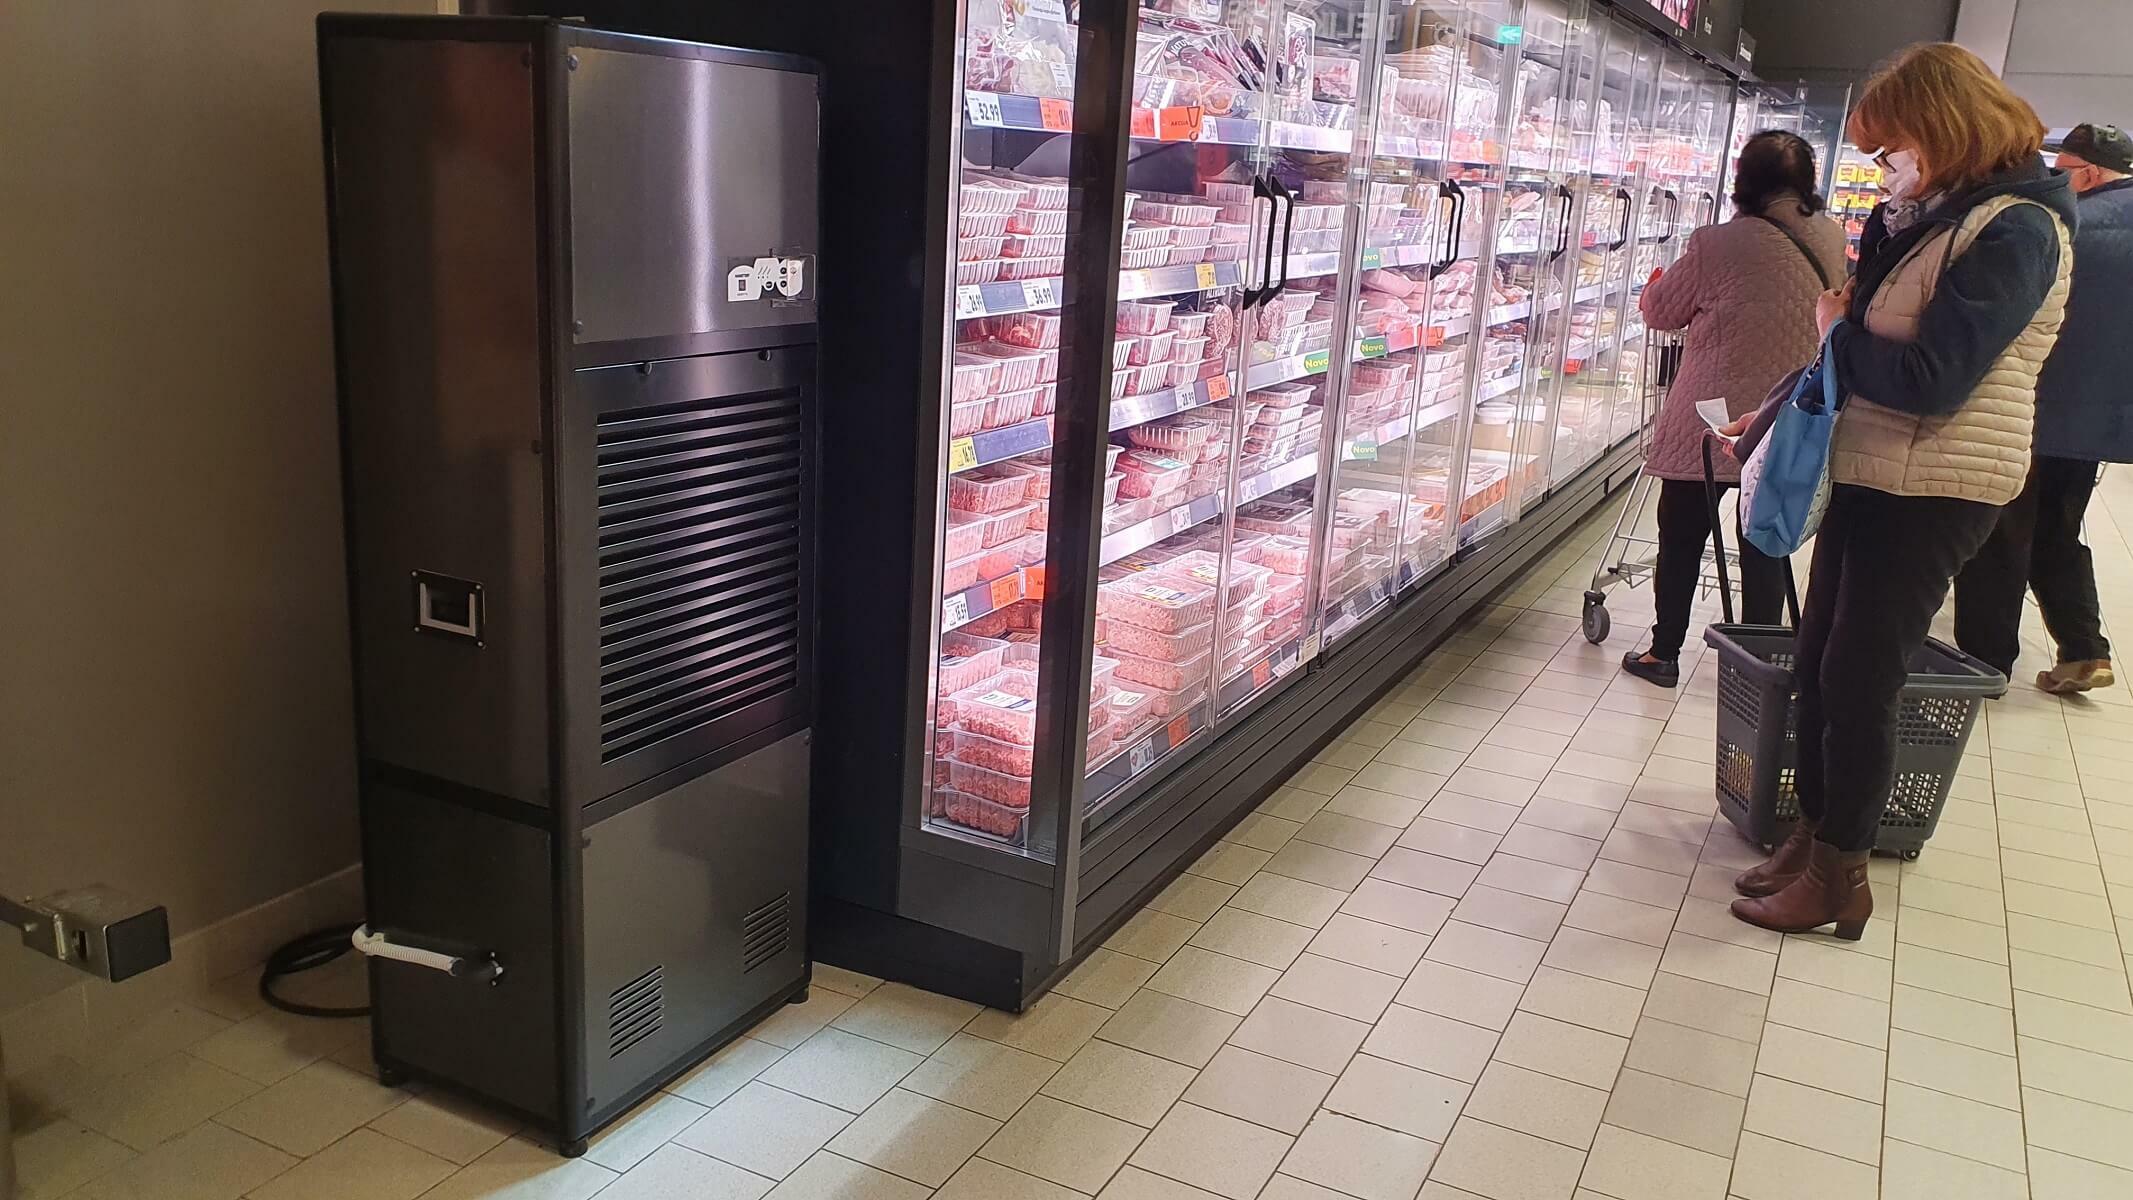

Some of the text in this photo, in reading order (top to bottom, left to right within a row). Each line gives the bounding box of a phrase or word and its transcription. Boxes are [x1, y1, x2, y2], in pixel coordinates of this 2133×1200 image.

[978, 102, 1000, 121] 52.99
[1360, 343, 1385, 353] Novo
[1304, 357, 1329, 370] Novo
[1352, 446, 1376, 454] Novo
